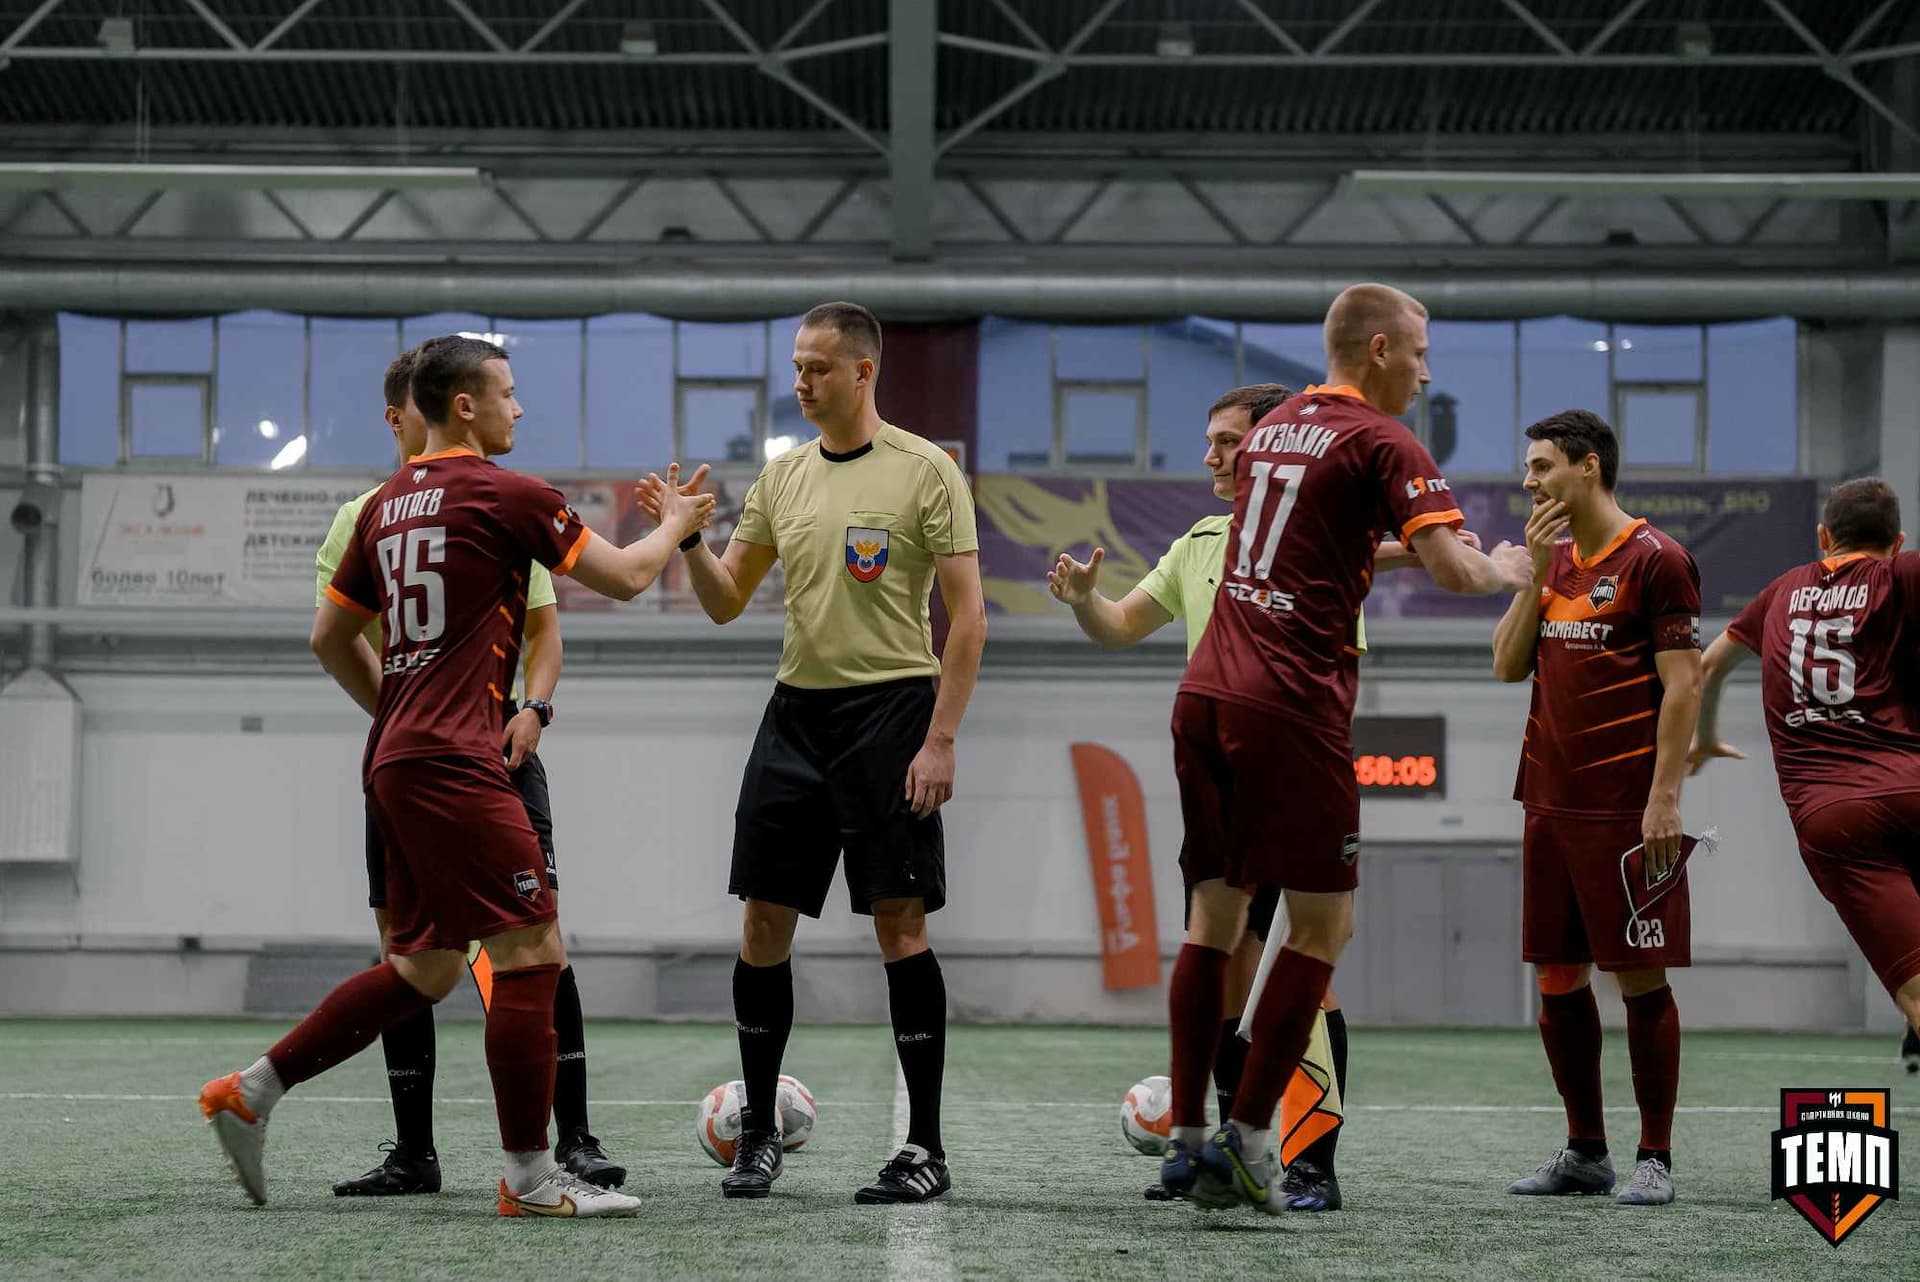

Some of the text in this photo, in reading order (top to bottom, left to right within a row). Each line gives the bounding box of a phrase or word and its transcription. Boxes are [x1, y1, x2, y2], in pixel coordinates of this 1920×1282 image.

[1247, 423, 1338, 459] КУЗЬКИН
[380, 488, 445, 529] ХУГАЕВ
[1232, 461, 1306, 580] 17
[376, 526, 447, 648] 55
[1789, 584, 1869, 615] АБРАМОВ
[1788, 615, 1857, 705] 15
[1639, 918, 1665, 949] 23
